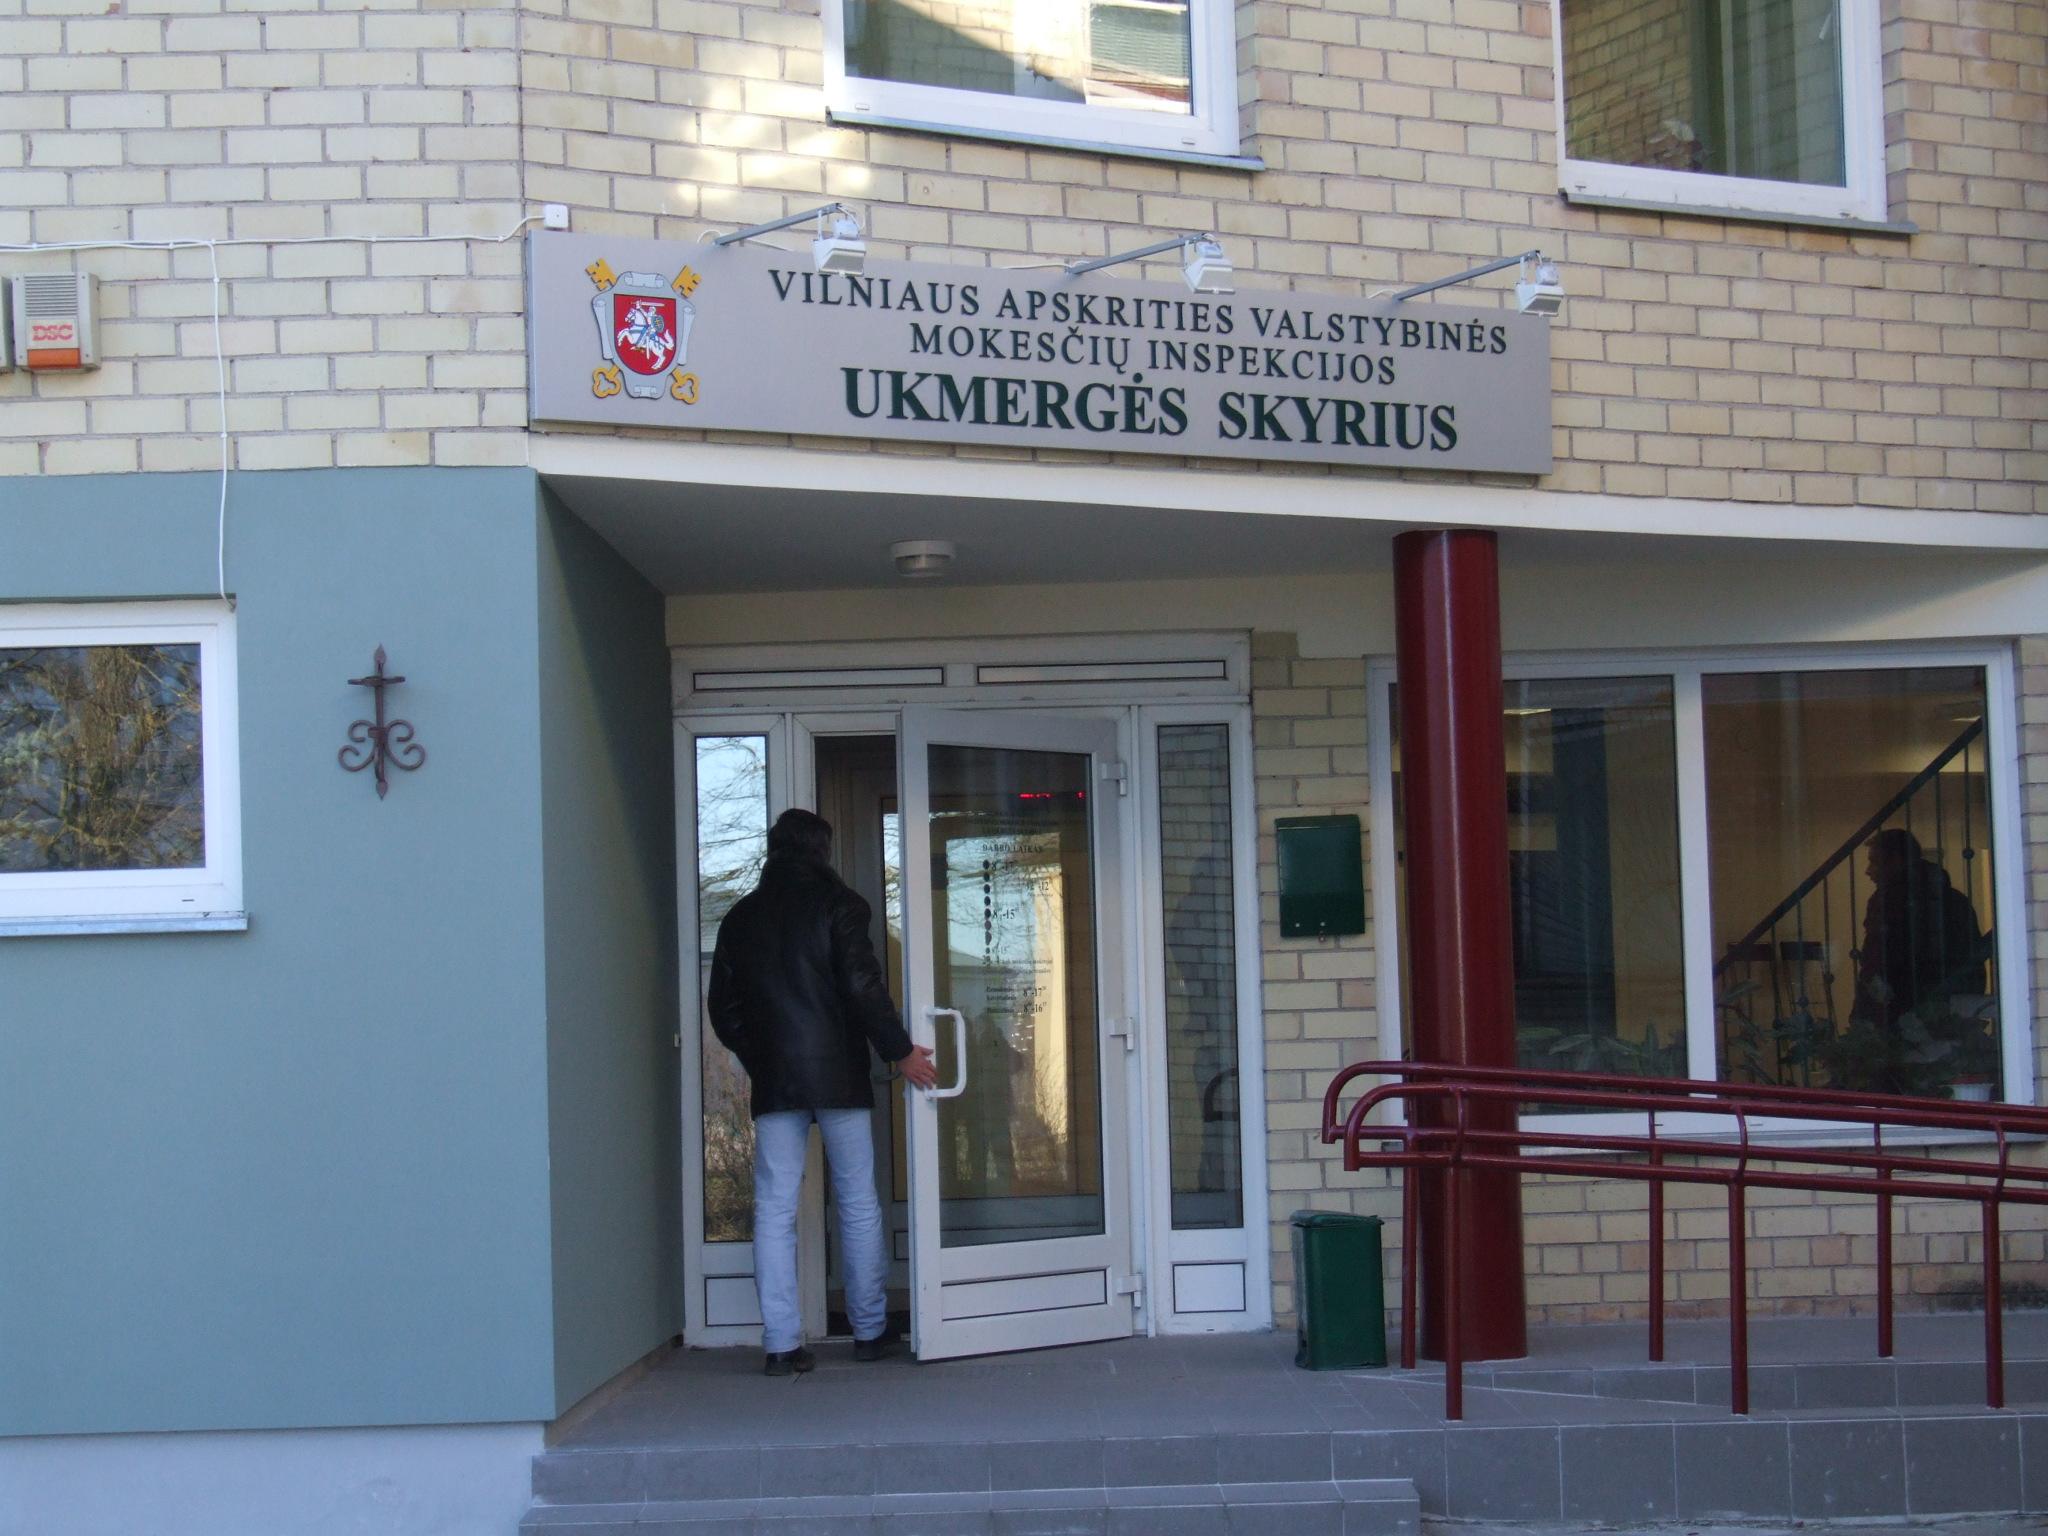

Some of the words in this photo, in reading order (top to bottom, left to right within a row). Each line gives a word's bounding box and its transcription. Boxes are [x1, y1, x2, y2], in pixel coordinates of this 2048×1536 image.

[31, 324, 73, 341] DSC
[768, 269, 979, 316] VILNIAUS
[995, 288, 1234, 335] APSKRITIES
[1249, 307, 1507, 355] VALSTYBINĖS
[909, 322, 1131, 375] MOKESČIŲ
[1148, 340, 1396, 386] INSPEKCIJOS
[840, 367, 1189, 437] UKMERGĖS
[1218, 391, 1458, 452] SKYRIUS
